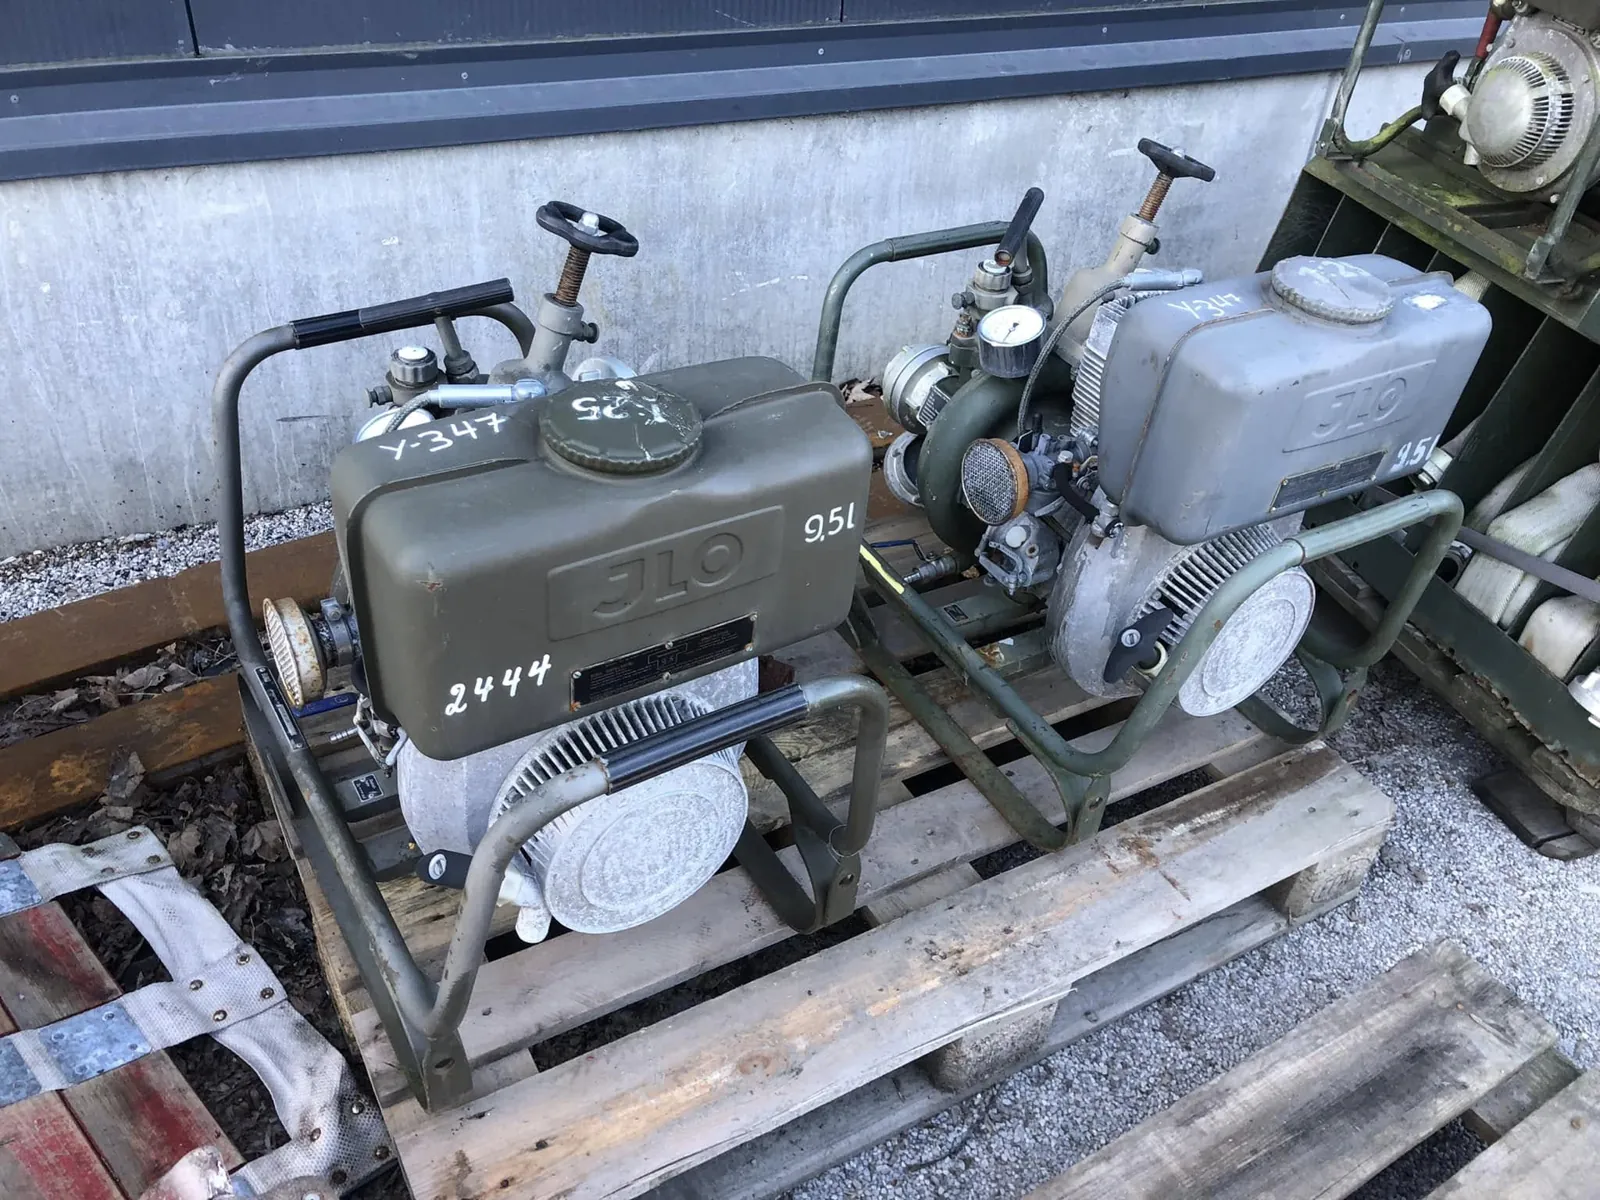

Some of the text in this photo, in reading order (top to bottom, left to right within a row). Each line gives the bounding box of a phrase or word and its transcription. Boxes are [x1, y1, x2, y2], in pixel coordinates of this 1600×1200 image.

[1167, 293, 1241, 319] Y-347
[379, 412, 506, 460] Y-347
[445, 653, 552, 716] 2444
